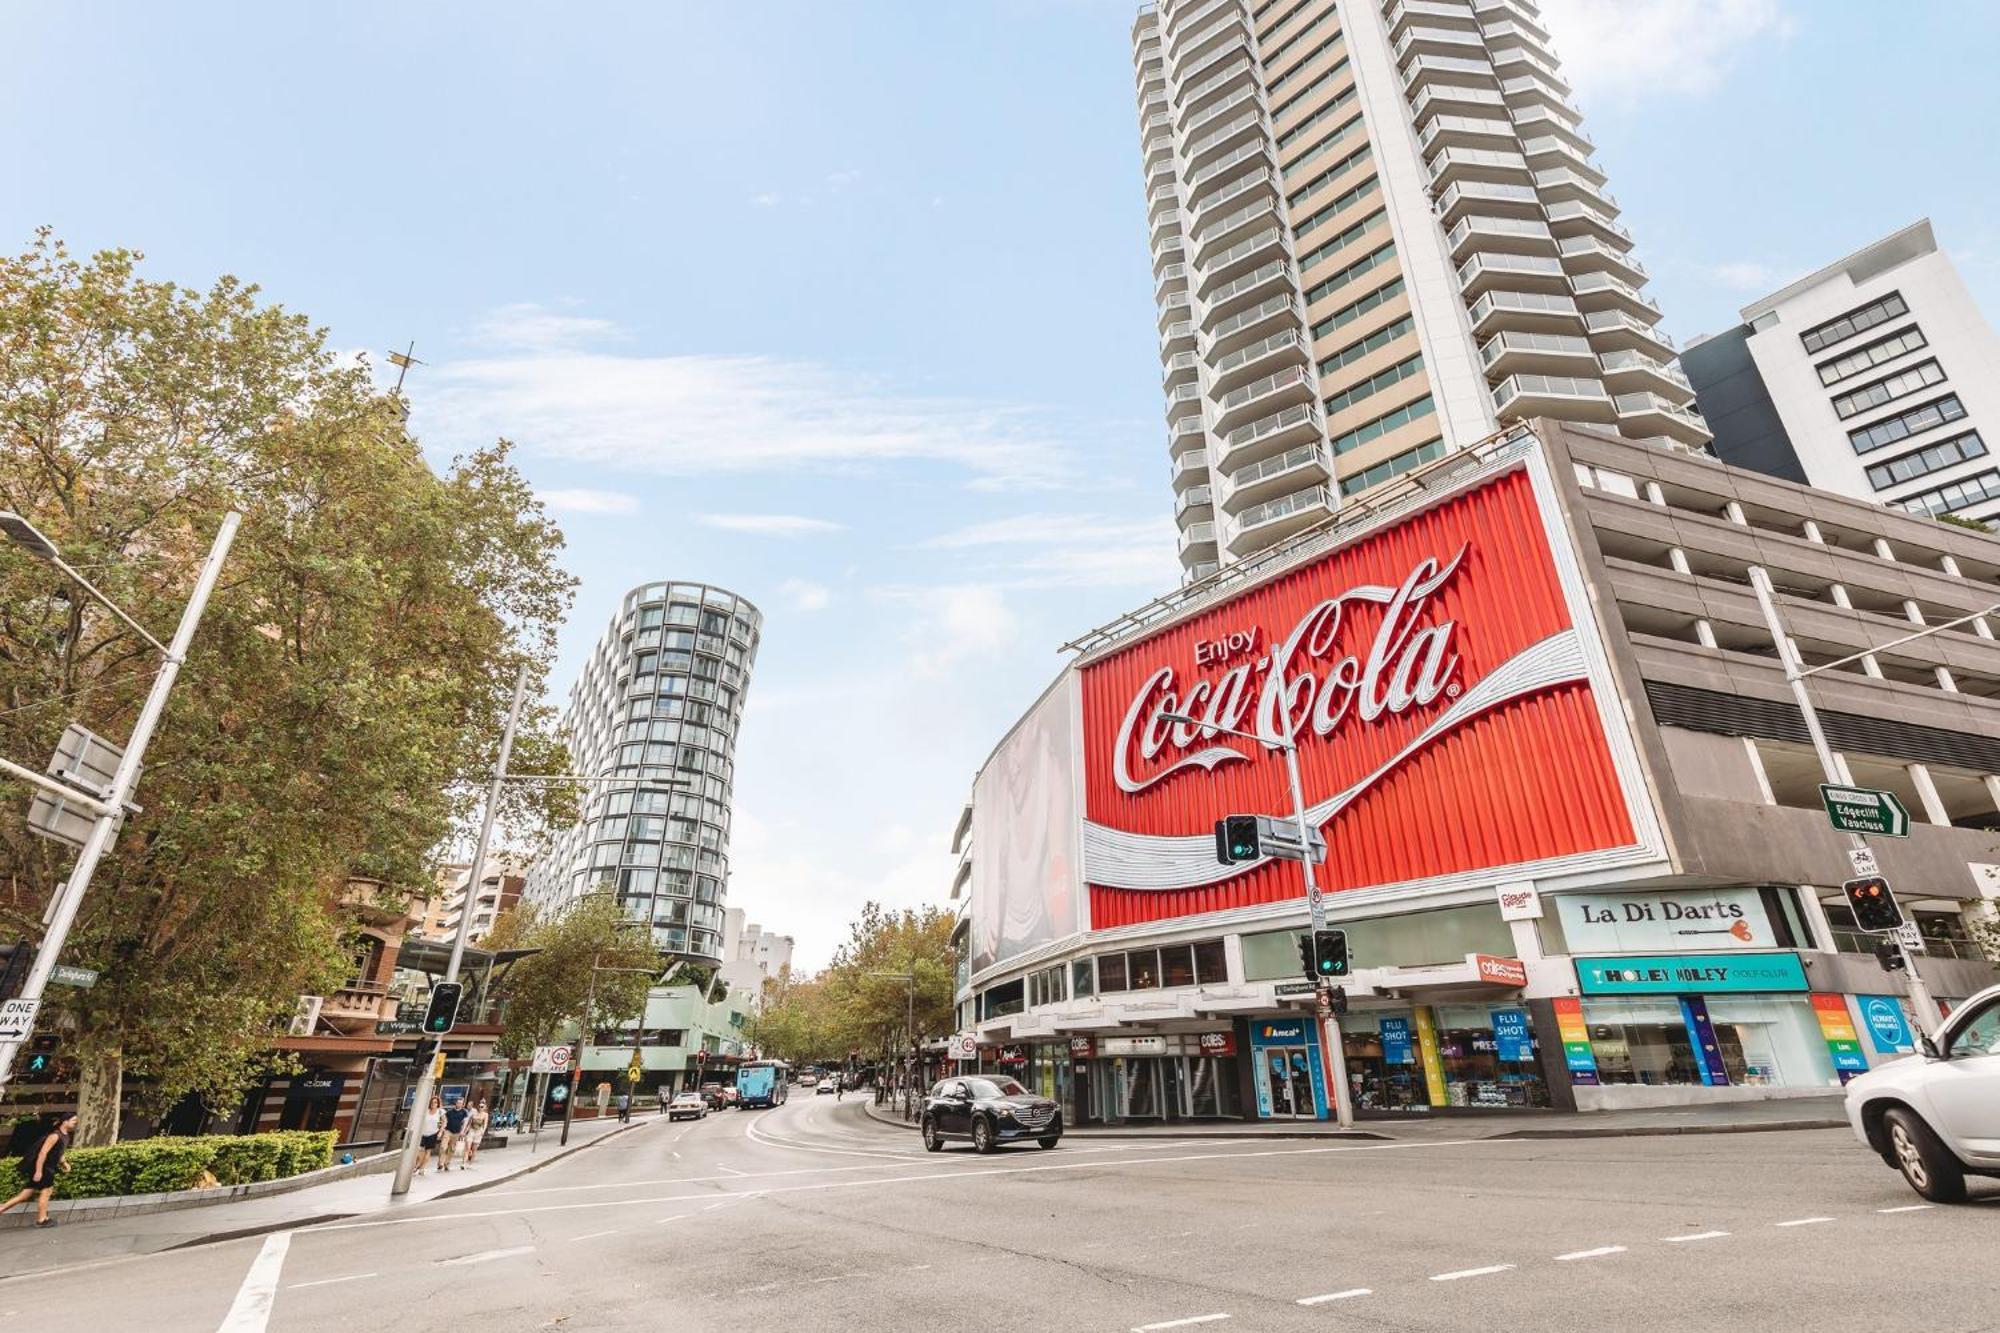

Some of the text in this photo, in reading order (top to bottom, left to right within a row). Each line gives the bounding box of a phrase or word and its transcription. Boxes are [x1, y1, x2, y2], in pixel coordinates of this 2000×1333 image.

[1194, 625, 1258, 665] Enjoy
[1835, 804, 1879, 819] Edgecliff
[1840, 816, 1885, 832] Vaucluse
[1855, 865, 1878, 874] LANE
[1581, 900, 1744, 923] La Di Darts
[1604, 969, 1670, 982] HOLEY
[1675, 967, 1728, 982] MOLEY
[7, 1003, 34, 1013] ONE
[0, 1016, 30, 1026] WAY
[1498, 1015, 1518, 1024] FLU
[1385, 1021, 1402, 1030] FLU
[1497, 1025, 1525, 1036] SHOT
[1384, 1031, 1407, 1041] SHOT
[554, 1053, 567, 1062] 40
